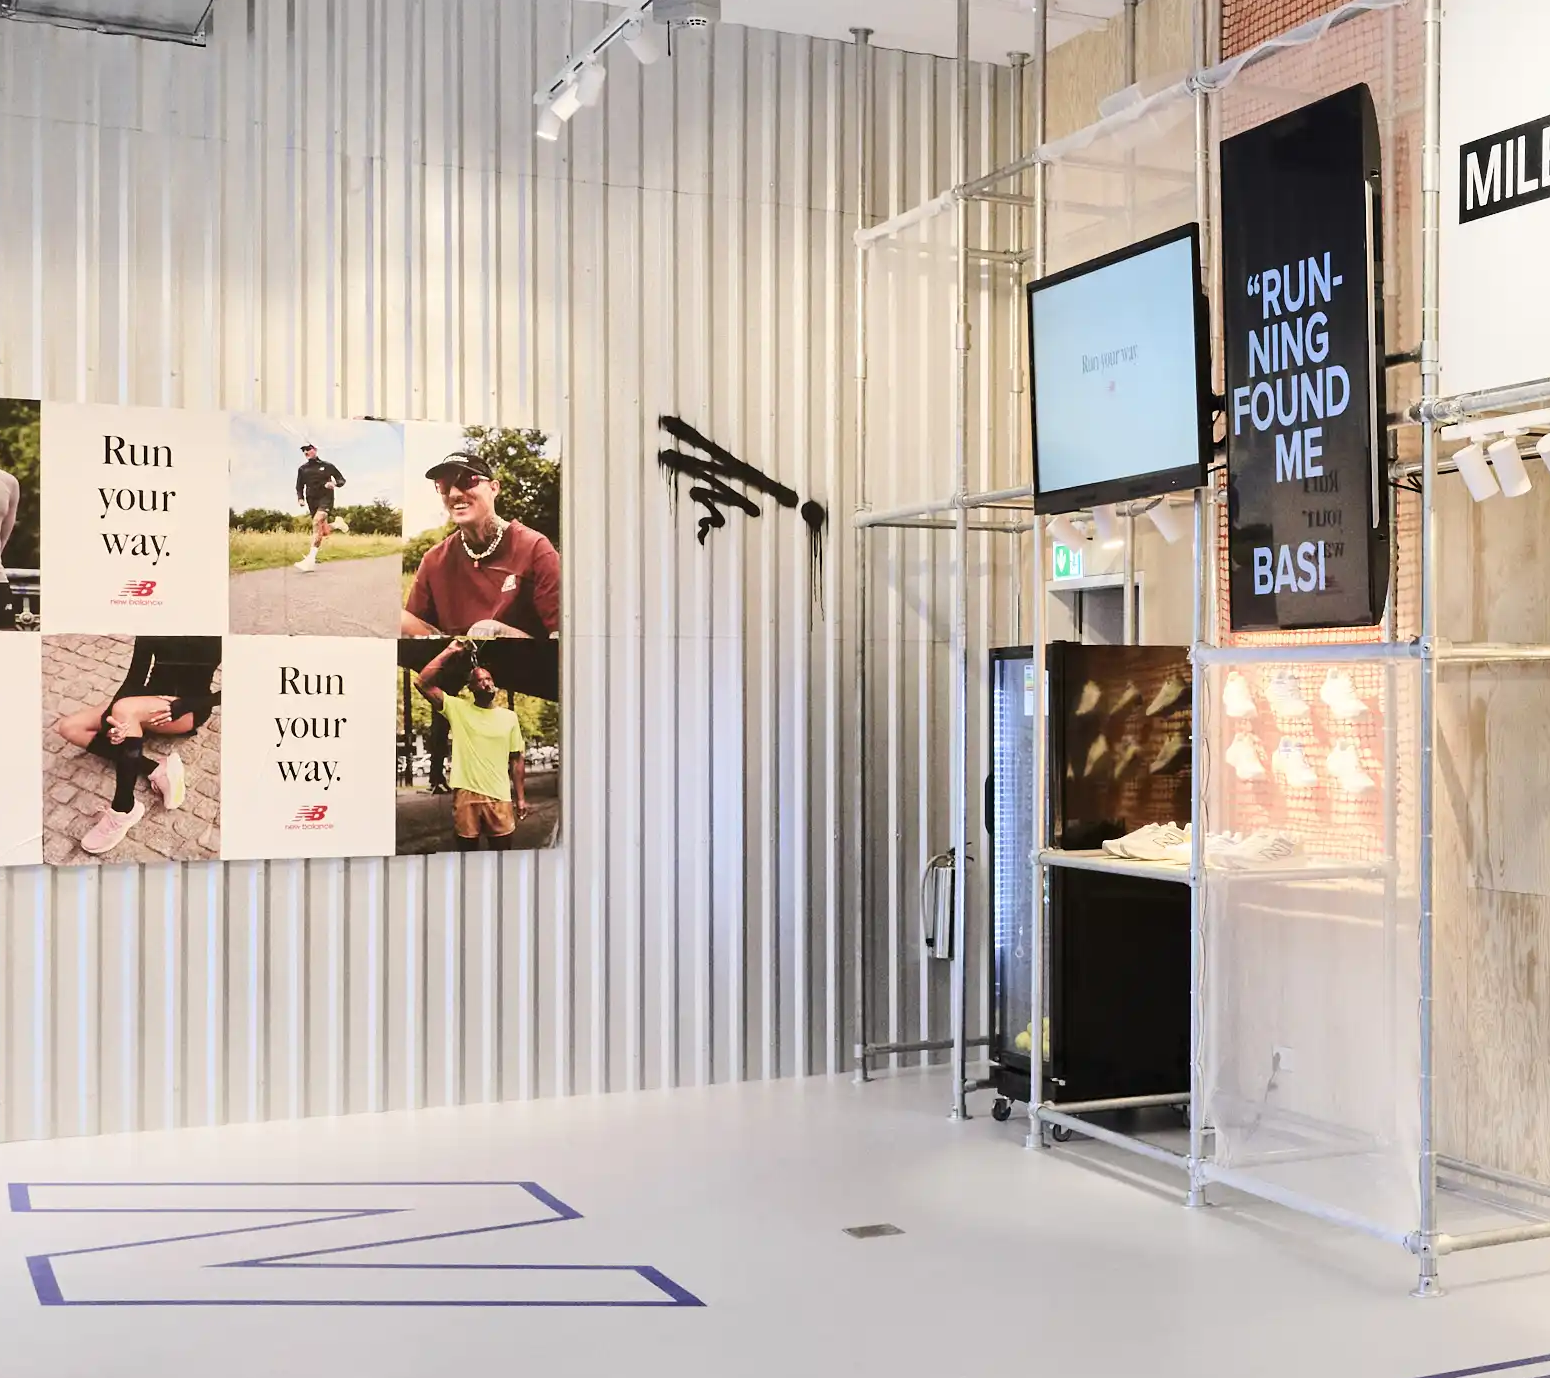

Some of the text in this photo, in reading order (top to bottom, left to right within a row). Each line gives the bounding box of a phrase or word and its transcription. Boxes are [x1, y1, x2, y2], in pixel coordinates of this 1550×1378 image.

[1249, 312, 1329, 378] NING
[1082, 354, 1099, 374] Run
[1101, 349, 1119, 376] your
[1234, 365, 1350, 435] FOUND
[103, 435, 172, 467] Run
[1276, 427, 1323, 483] ME
[98, 488, 176, 519] your
[101, 533, 170, 565] way.
[1253, 541, 1326, 595] BASI
[129, 598, 163, 606] balance
[279, 666, 345, 695] Run
[275, 717, 346, 747] your
[277, 760, 341, 790] way.
